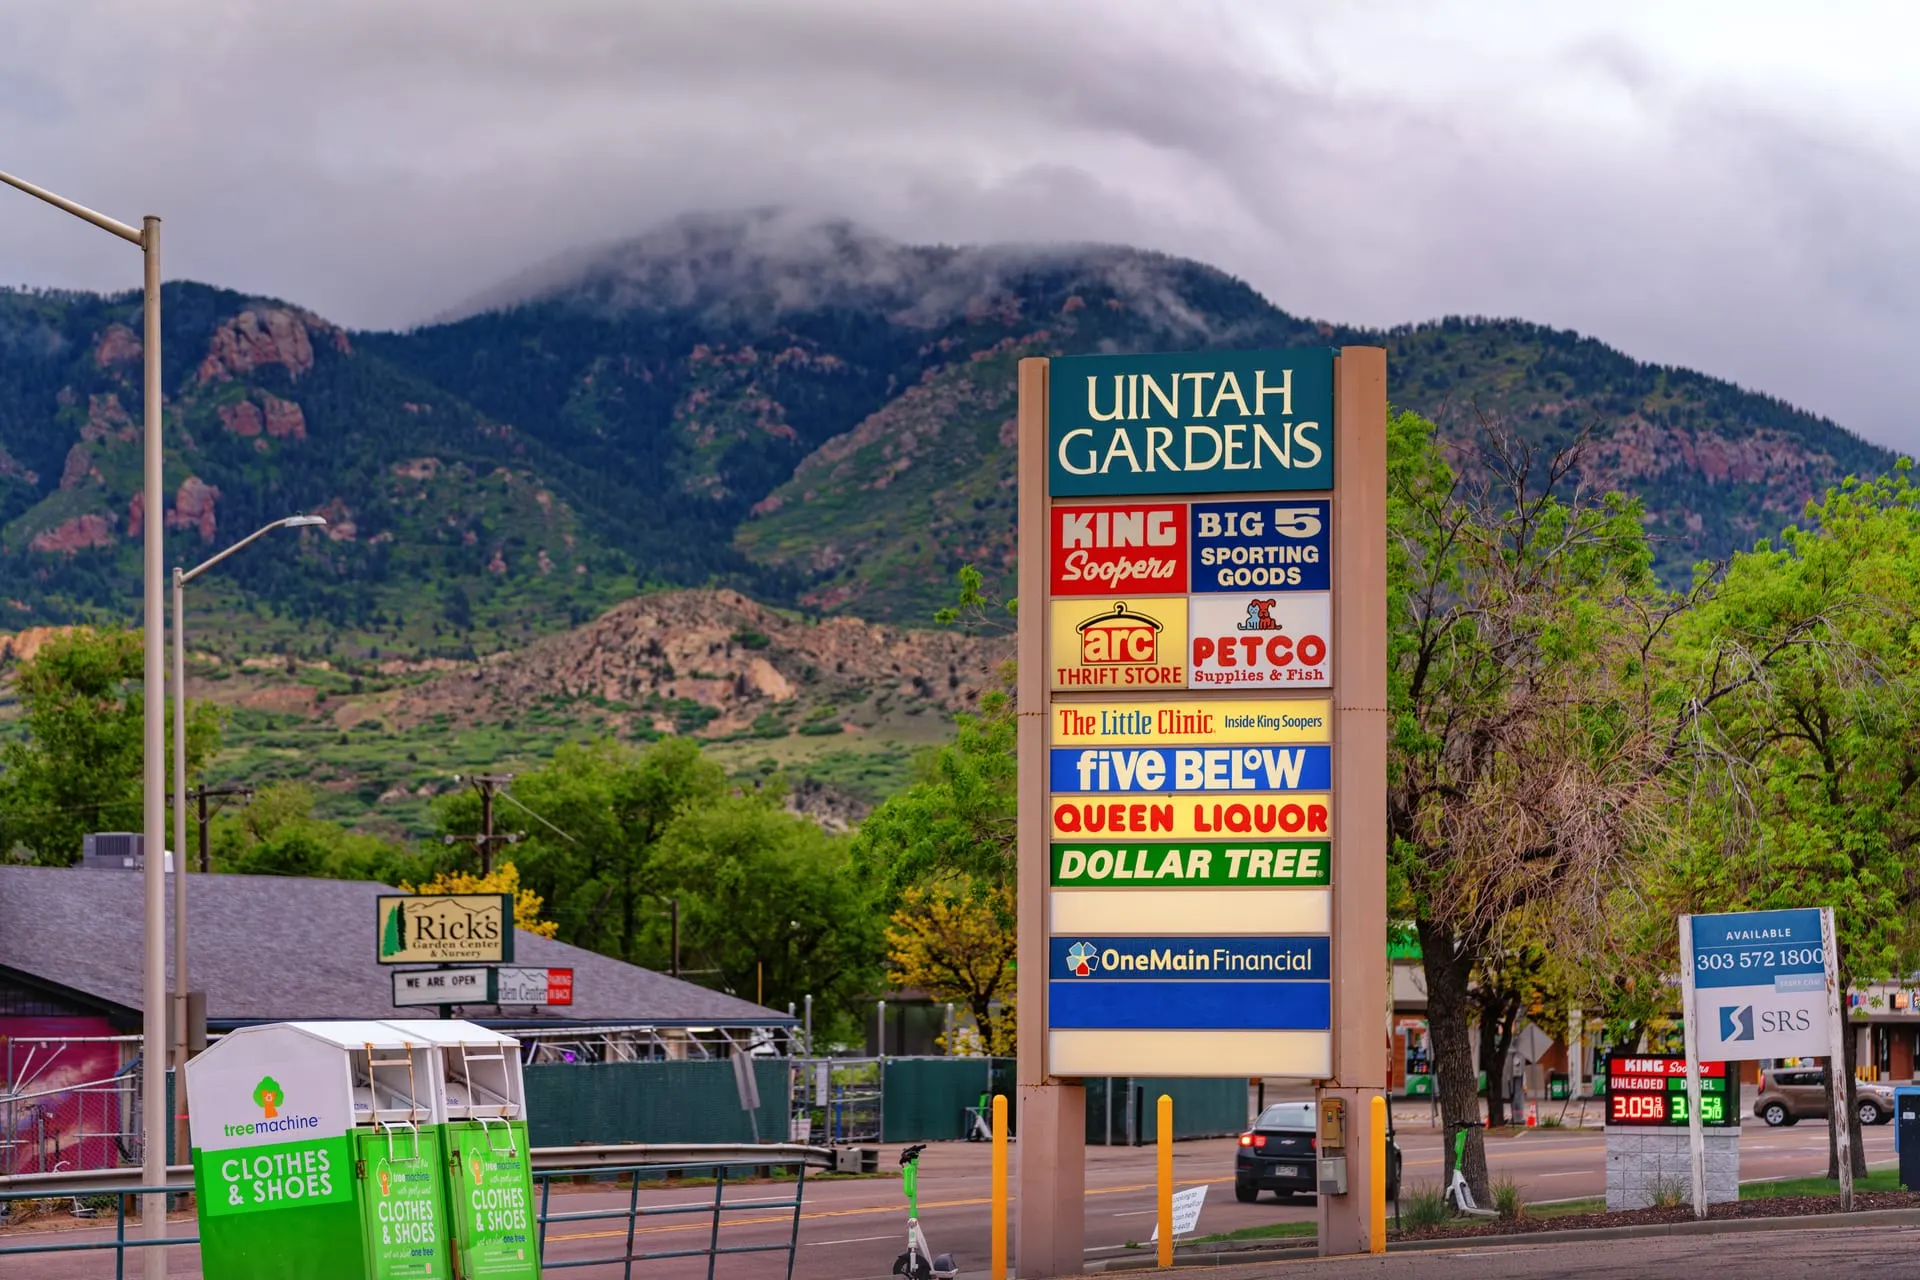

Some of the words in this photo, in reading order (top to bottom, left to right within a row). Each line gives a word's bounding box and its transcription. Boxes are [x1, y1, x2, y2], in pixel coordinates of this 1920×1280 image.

[1086, 368, 1294, 422] UINTAH
[1058, 421, 1322, 475] GARDENS
[1061, 510, 1177, 549] KING
[1198, 511, 1265, 538] BIG
[1274, 507, 1322, 538] 5
[1200, 545, 1319, 566] SPORTING
[1061, 550, 1177, 588] Soopers
[1217, 567, 1302, 586] GOODS
[1084, 629, 1154, 661] arc
[1193, 635, 1326, 667] PETCO
[1057, 667, 1119, 685] THRIFT
[1124, 666, 1182, 684] STORE
[1194, 670, 1264, 684] Supplies
[1269, 669, 1282, 681] &
[1286, 669, 1324, 681] Fish
[1059, 710, 1096, 735] The
[1101, 710, 1152, 735] Little
[1157, 709, 1213, 734] Clinic
[1225, 715, 1255, 728] Inside
[1257, 715, 1280, 730] King
[1282, 714, 1322, 730] Soopers
[1076, 749, 1166, 790] five
[1175, 749, 1306, 789] BELOW
[1053, 804, 1174, 833] QUEEN
[1194, 803, 1328, 833] LIQUOR
[1058, 850, 1212, 879] DOLLAR
[412, 940, 456, 949] Garden
[459, 940, 499, 949] Center
[1726, 928, 1791, 941] AVAILABLE
[441, 949, 481, 958] Nursery
[1697, 953, 1734, 970] 303
[1739, 952, 1775, 968] 572
[1780, 948, 1824, 966] 1800
[406, 978, 420, 988] WE
[427, 976, 445, 987] ARE
[451, 975, 476, 985] OPEN
[1761, 1010, 1810, 1033] SRS
[1624, 1059, 1664, 1072] KING
[1611, 1078, 1664, 1090] UNLEADED
[1613, 1097, 1654, 1118] 3.09
[1671, 1097, 1712, 1119] 3.5
[224, 1114, 319, 1137] treemachine
[222, 1149, 331, 1182] CLOTHES
[228, 1184, 245, 1206] &
[253, 1172, 333, 1203] SHOES
[472, 1187, 525, 1210] CLOTHES
[378, 1200, 433, 1222] CLOTHES
[476, 1212, 485, 1232] &
[488, 1210, 526, 1231] SHOES
[382, 1224, 391, 1244] &
[395, 1222, 435, 1244] SHOES
